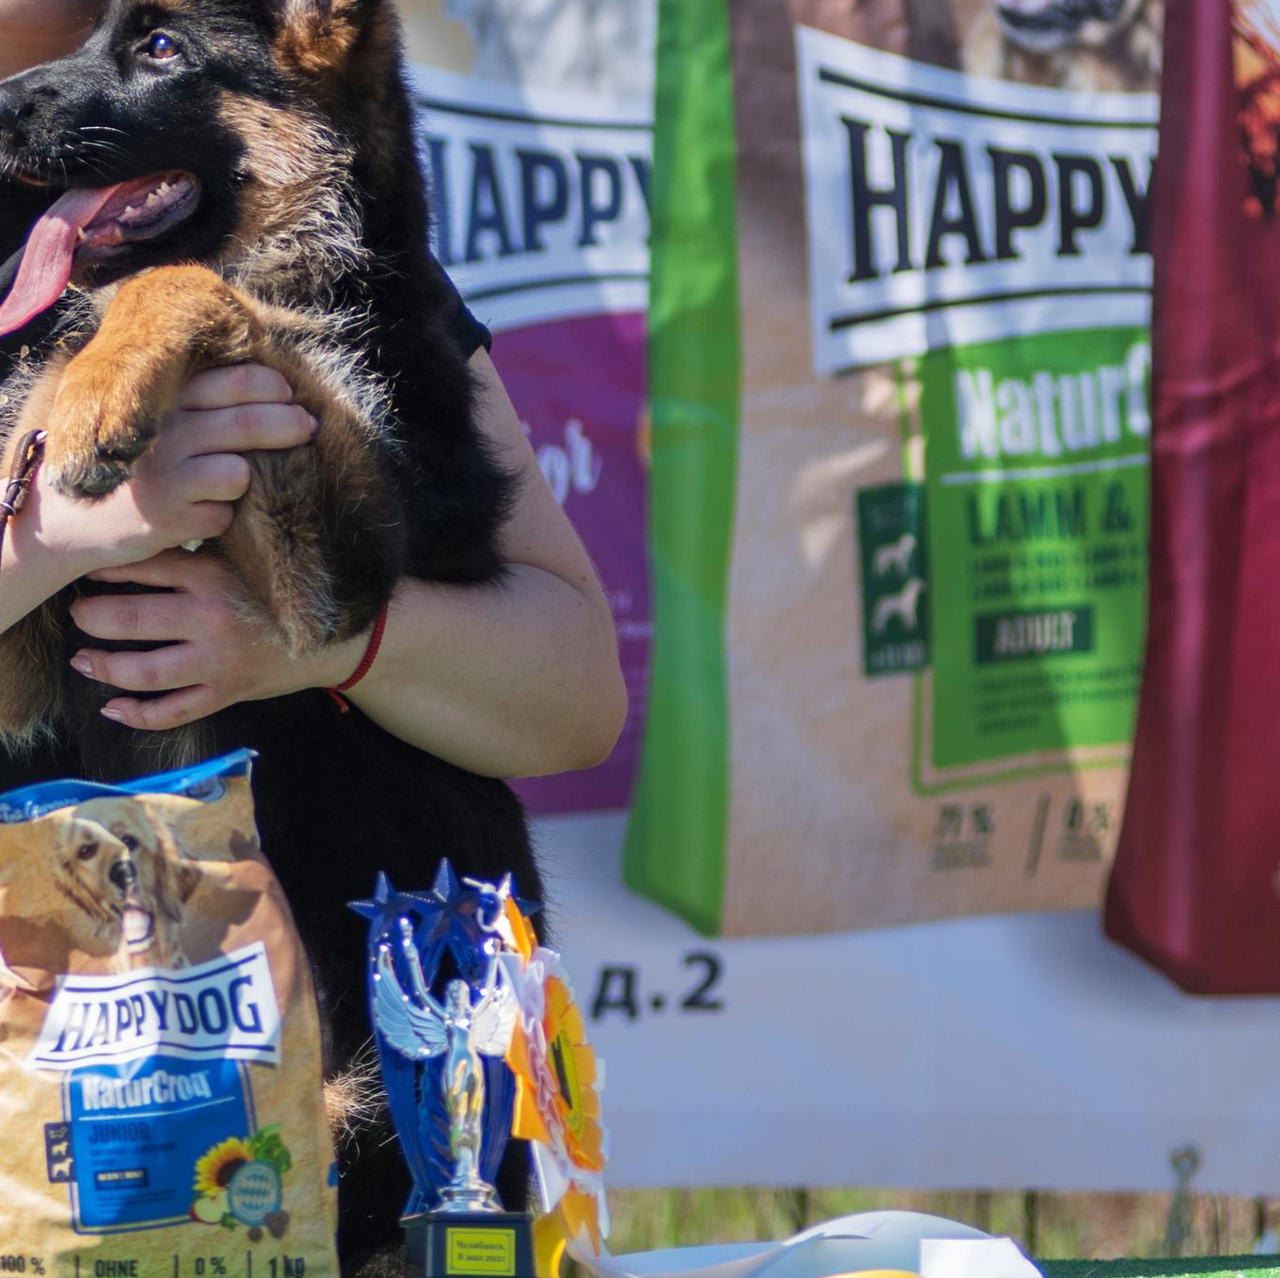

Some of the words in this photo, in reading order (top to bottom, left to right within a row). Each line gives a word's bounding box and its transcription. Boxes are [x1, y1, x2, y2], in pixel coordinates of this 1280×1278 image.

[173, 976, 263, 1034] DOG
[81, 1070, 213, 1110] NaturCroq
[0, 1255, 26, 1273] 100
[31, 1257, 46, 1276] %
[94, 1259, 138, 1278] OHNE
